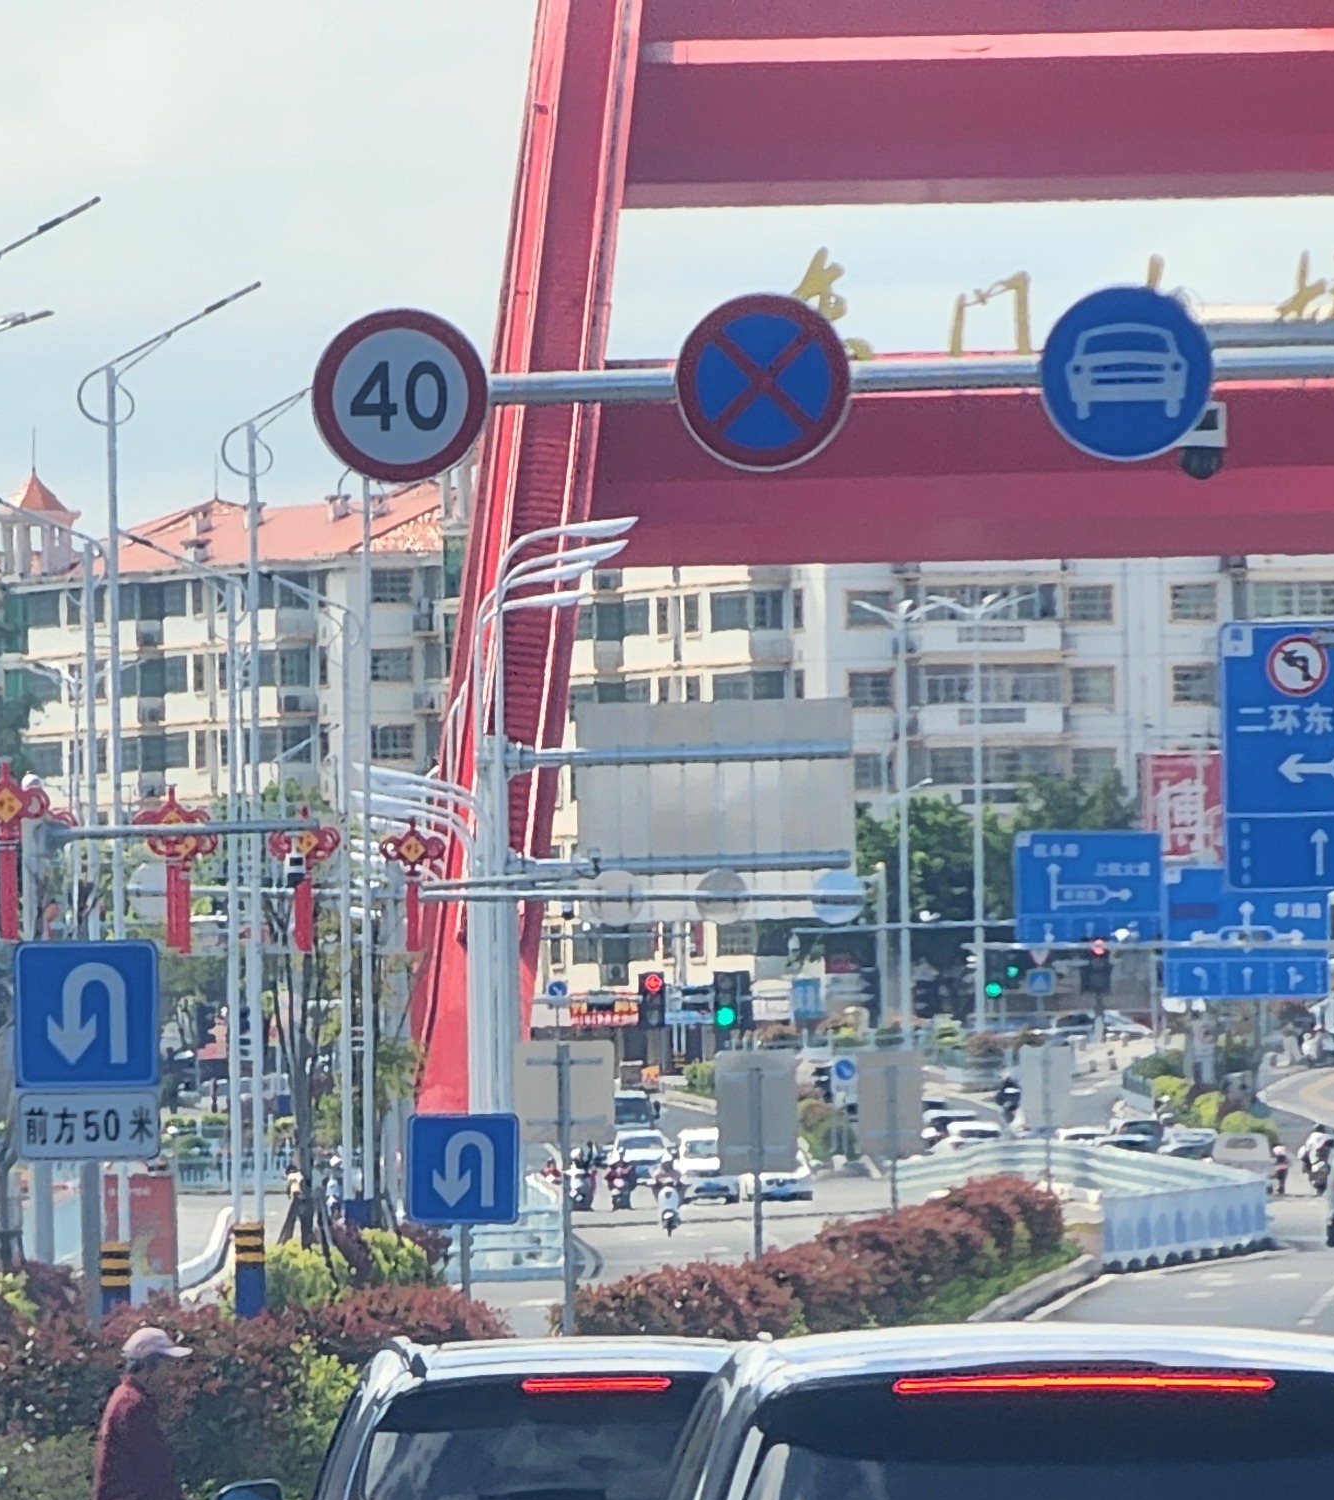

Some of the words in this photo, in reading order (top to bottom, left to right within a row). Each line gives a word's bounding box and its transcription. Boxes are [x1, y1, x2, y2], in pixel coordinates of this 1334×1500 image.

[350, 361, 448, 431] 40
[24, 1105, 154, 1146] 前方50米
